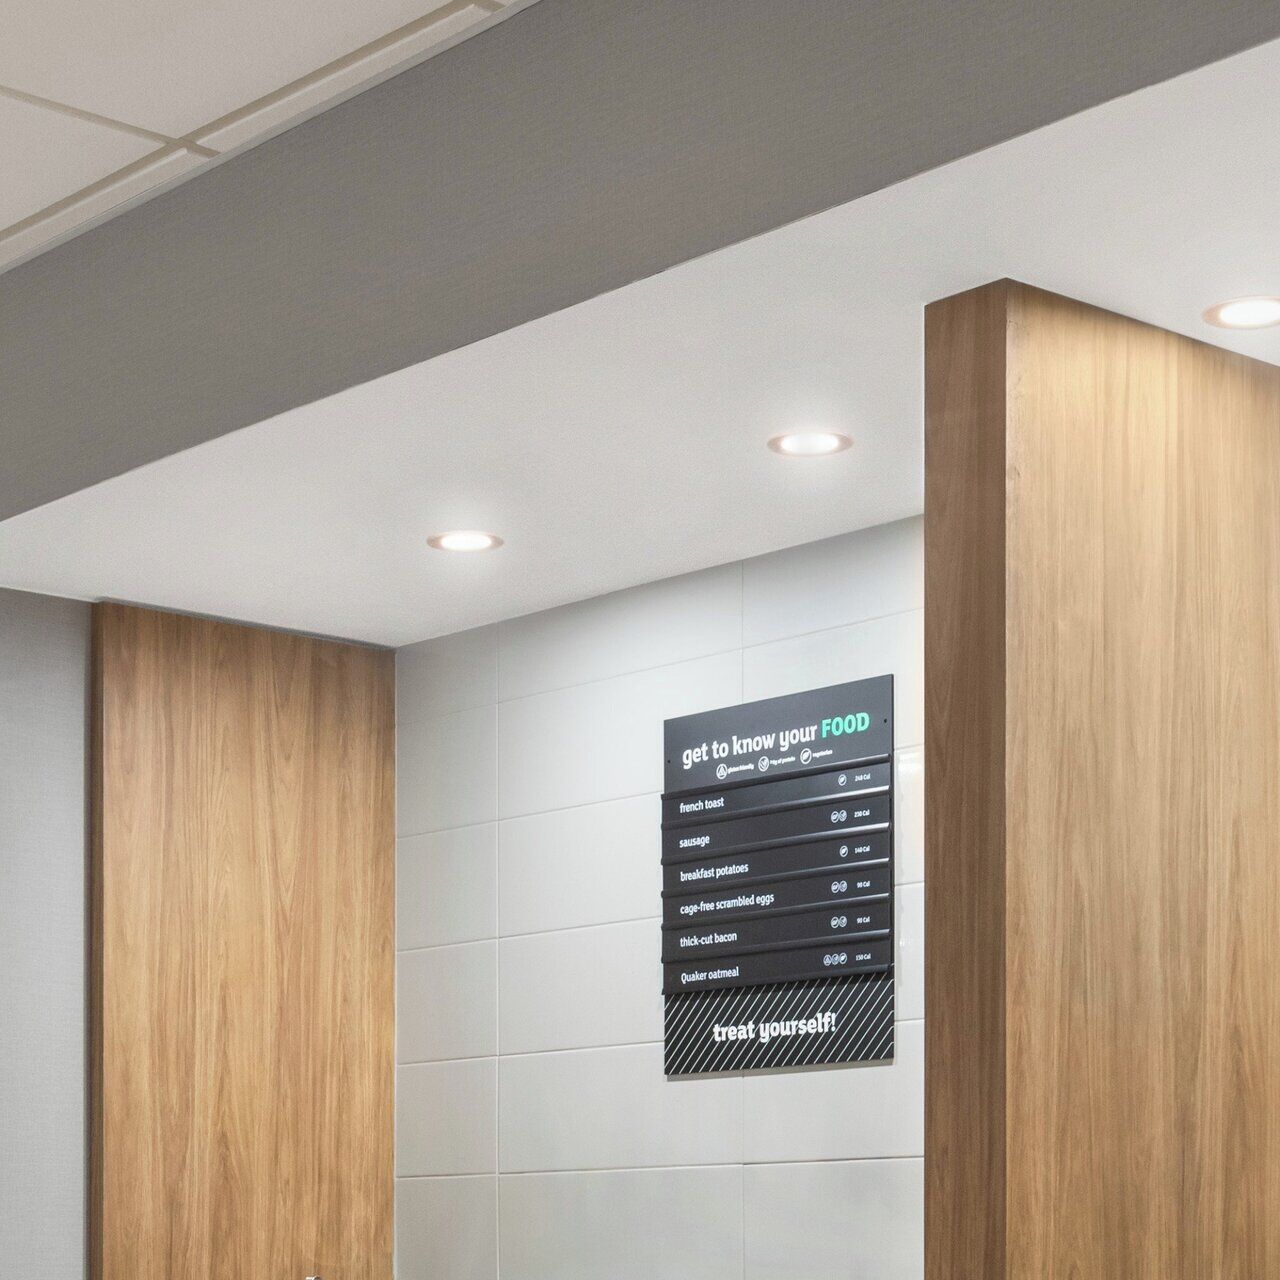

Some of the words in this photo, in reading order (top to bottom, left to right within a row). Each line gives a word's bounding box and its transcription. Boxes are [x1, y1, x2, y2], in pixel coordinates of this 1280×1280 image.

[682, 745, 709, 769] get
[712, 738, 729, 759] to
[732, 731, 775, 755] know
[779, 725, 818, 751] your
[821, 711, 870, 738] FOOD
[680, 800, 704, 813] french
[705, 797, 724, 809] toast
[679, 836, 710, 848] sausage
[680, 867, 715, 882] breakfast
[716, 864, 749, 879] potatoes
[680, 901, 715, 915] cage-free
[716, 894, 755, 909] scrambled
[756, 894, 775, 906] eggs
[680, 934, 713, 947] thick-cut
[714, 933, 738, 943] bacon
[681, 970, 707, 984] Quaker
[708, 966, 739, 979] oatmeal
[713, 1020, 756, 1042] treat
[759, 1011, 837, 1043] yourself!
